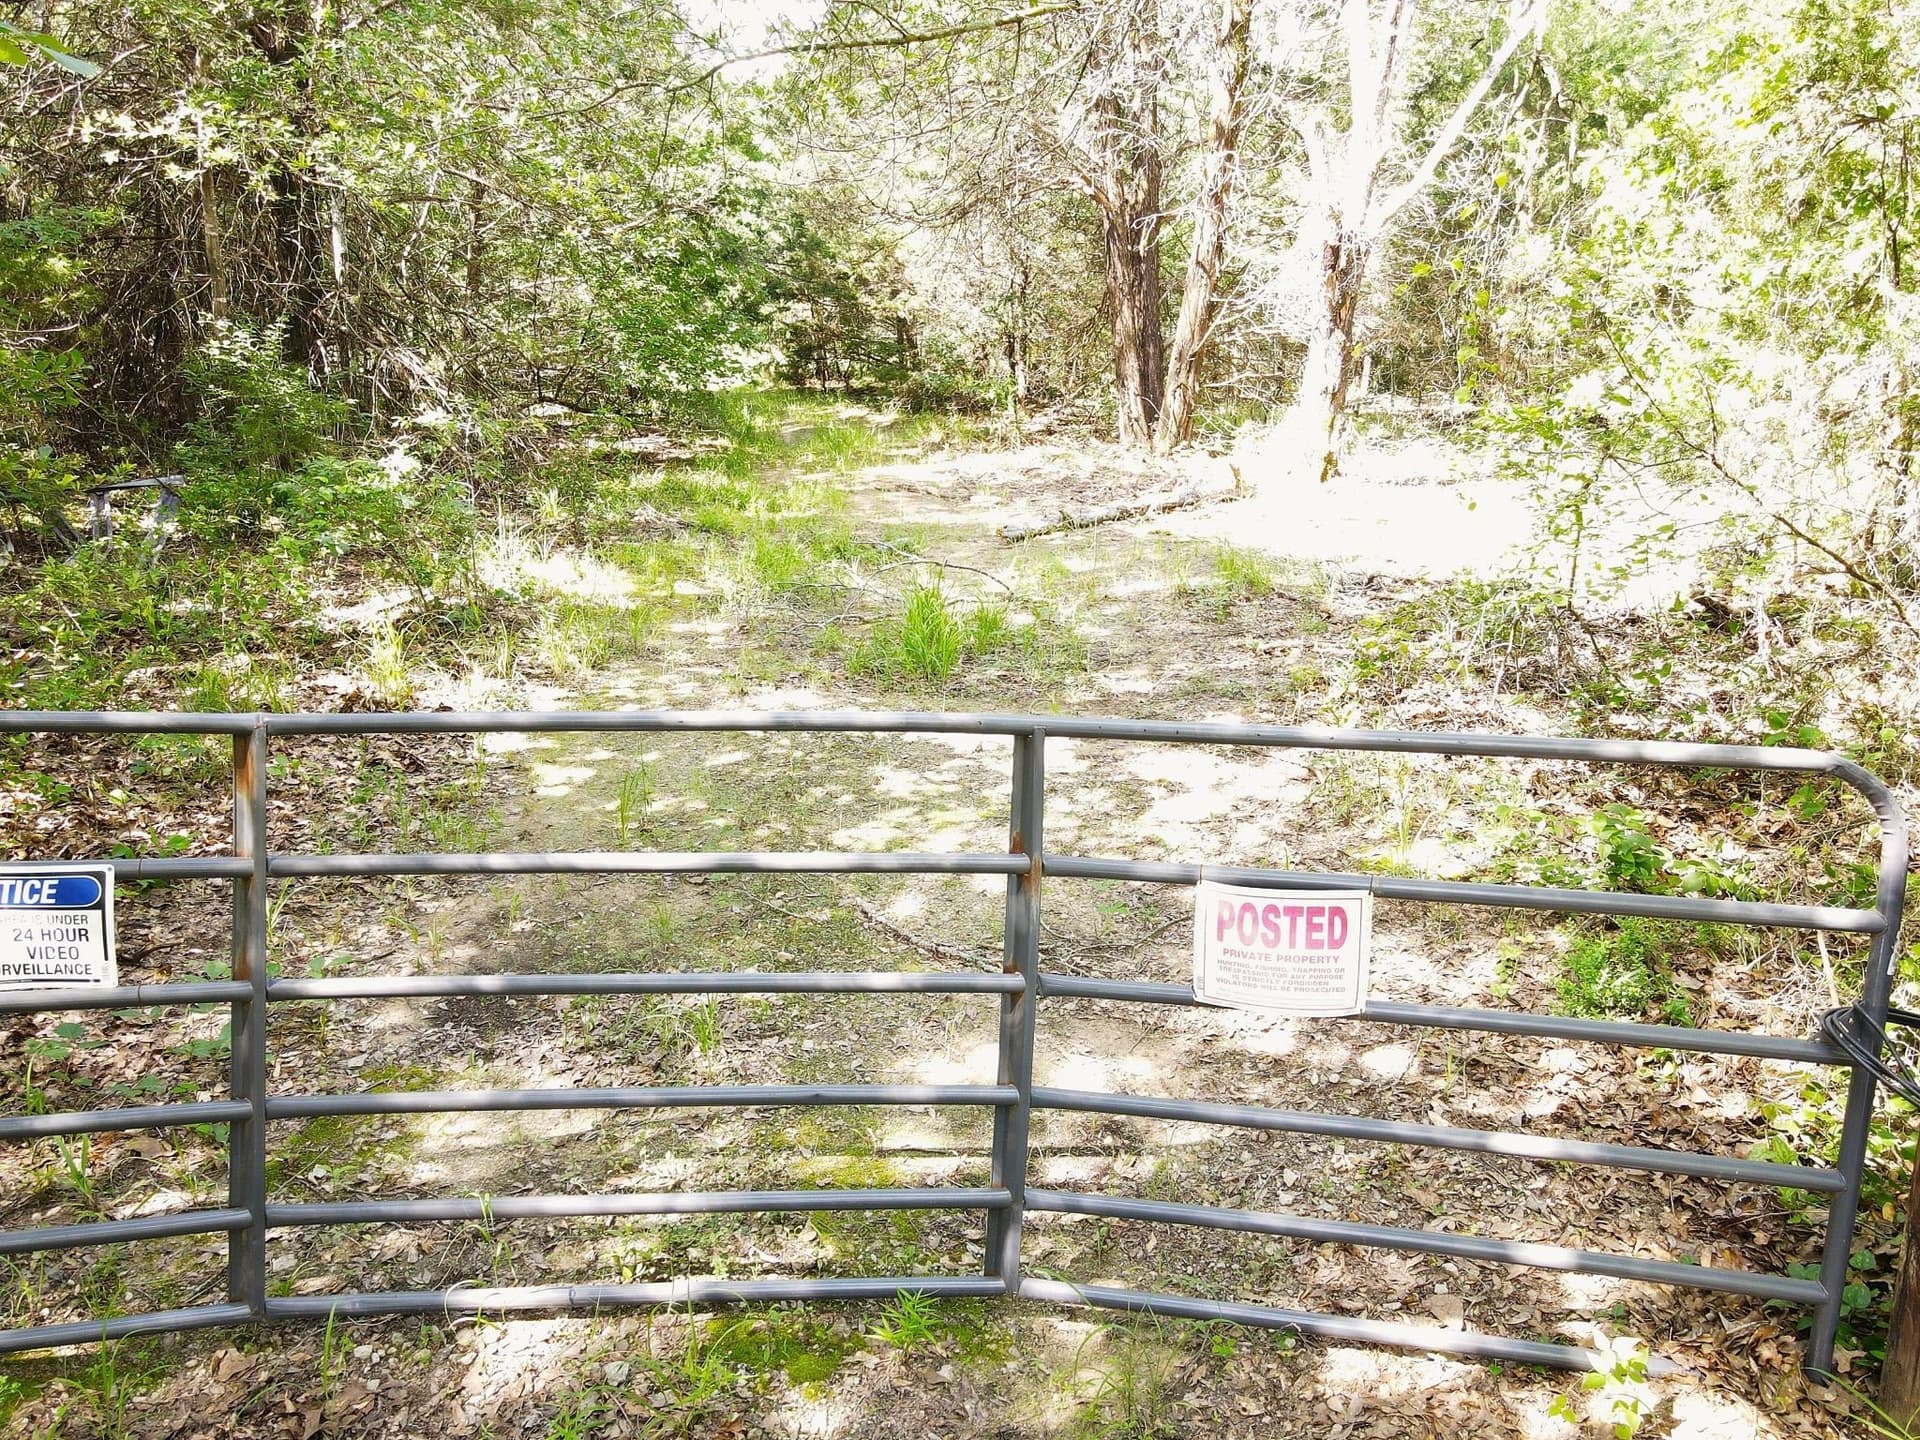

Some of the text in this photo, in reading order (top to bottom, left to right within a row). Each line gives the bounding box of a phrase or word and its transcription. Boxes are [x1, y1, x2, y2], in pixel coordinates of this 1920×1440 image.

[46, 914, 88, 925] UNDER
[1216, 901, 1348, 950] POSTED
[13, 927, 89, 942] 24 HOUR
[27, 946, 79, 960] VIDEO
[1223, 948, 1340, 964] PRIVATE PROPERTY
[0, 963, 93, 976] RVEILLANCE
